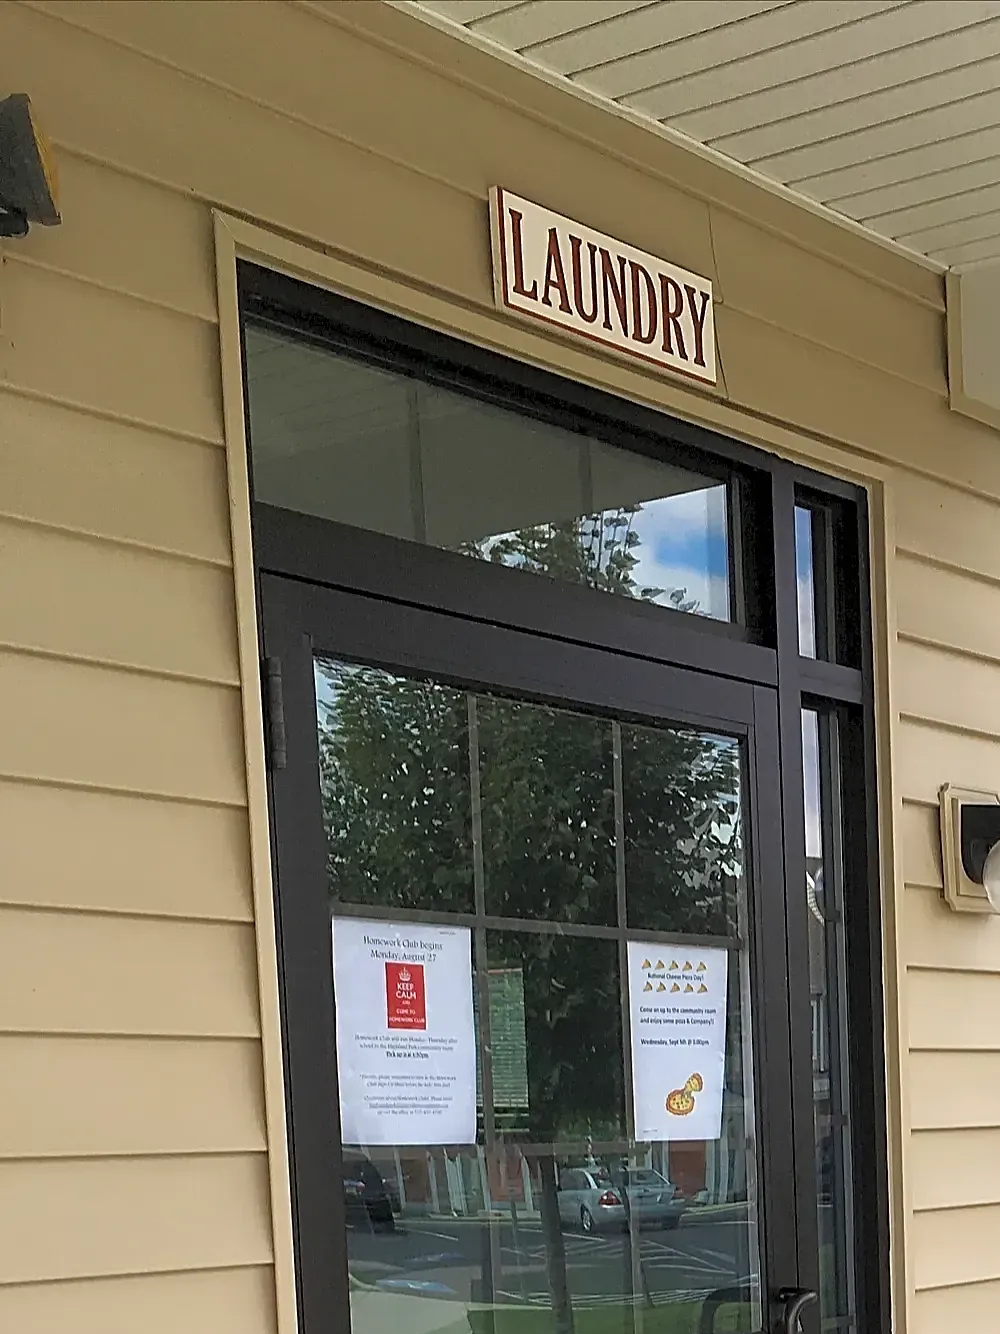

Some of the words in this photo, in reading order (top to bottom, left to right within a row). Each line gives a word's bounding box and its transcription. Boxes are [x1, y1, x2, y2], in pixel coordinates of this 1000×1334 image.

[508, 207, 710, 368] LAUNDRY
[363, 935, 401, 947] Homework
[402, 939, 419, 948] Club
[420, 940, 443, 951] begins
[370, 949, 401, 960] Monday,
[402, 952, 425, 962] August
[427, 953, 436, 962] 27
[397, 983, 414, 991] KEEP
[395, 990, 417, 999] CALM
[680, 1007, 704, 1015] community
